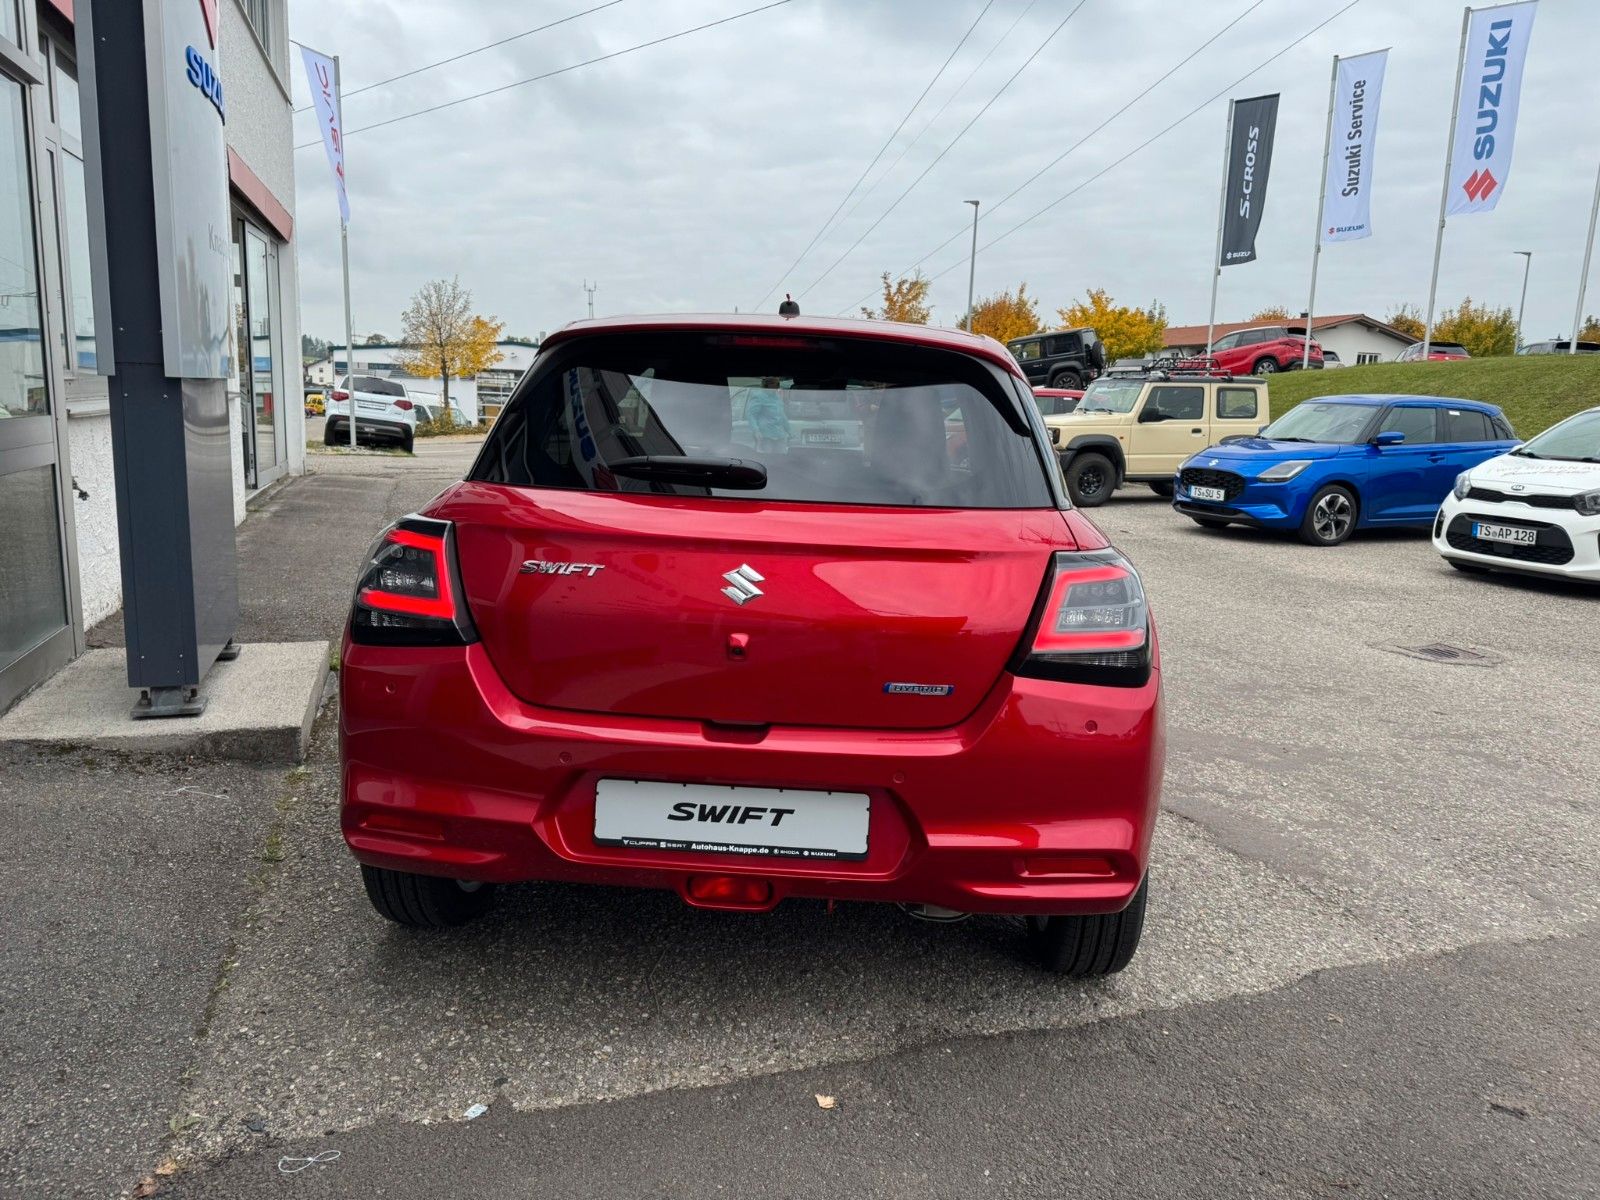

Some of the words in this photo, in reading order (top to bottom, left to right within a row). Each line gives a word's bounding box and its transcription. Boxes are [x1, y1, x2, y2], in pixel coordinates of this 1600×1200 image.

[186, 45, 226, 126] SUZU
[1347, 79, 1366, 140] Service
[1474, 19, 1513, 160] SUZUKI
[1239, 126, 1260, 219] S-CROSS
[1342, 143, 1362, 197] Suzuki
[1478, 525, 1491, 536] TS
[1497, 528, 1512, 539] AP
[1513, 530, 1535, 543] 128
[520, 560, 606, 577] SWIFT
[667, 802, 795, 827] SWIFT
[691, 843, 769, 854] Autohaus-Knappe.de
